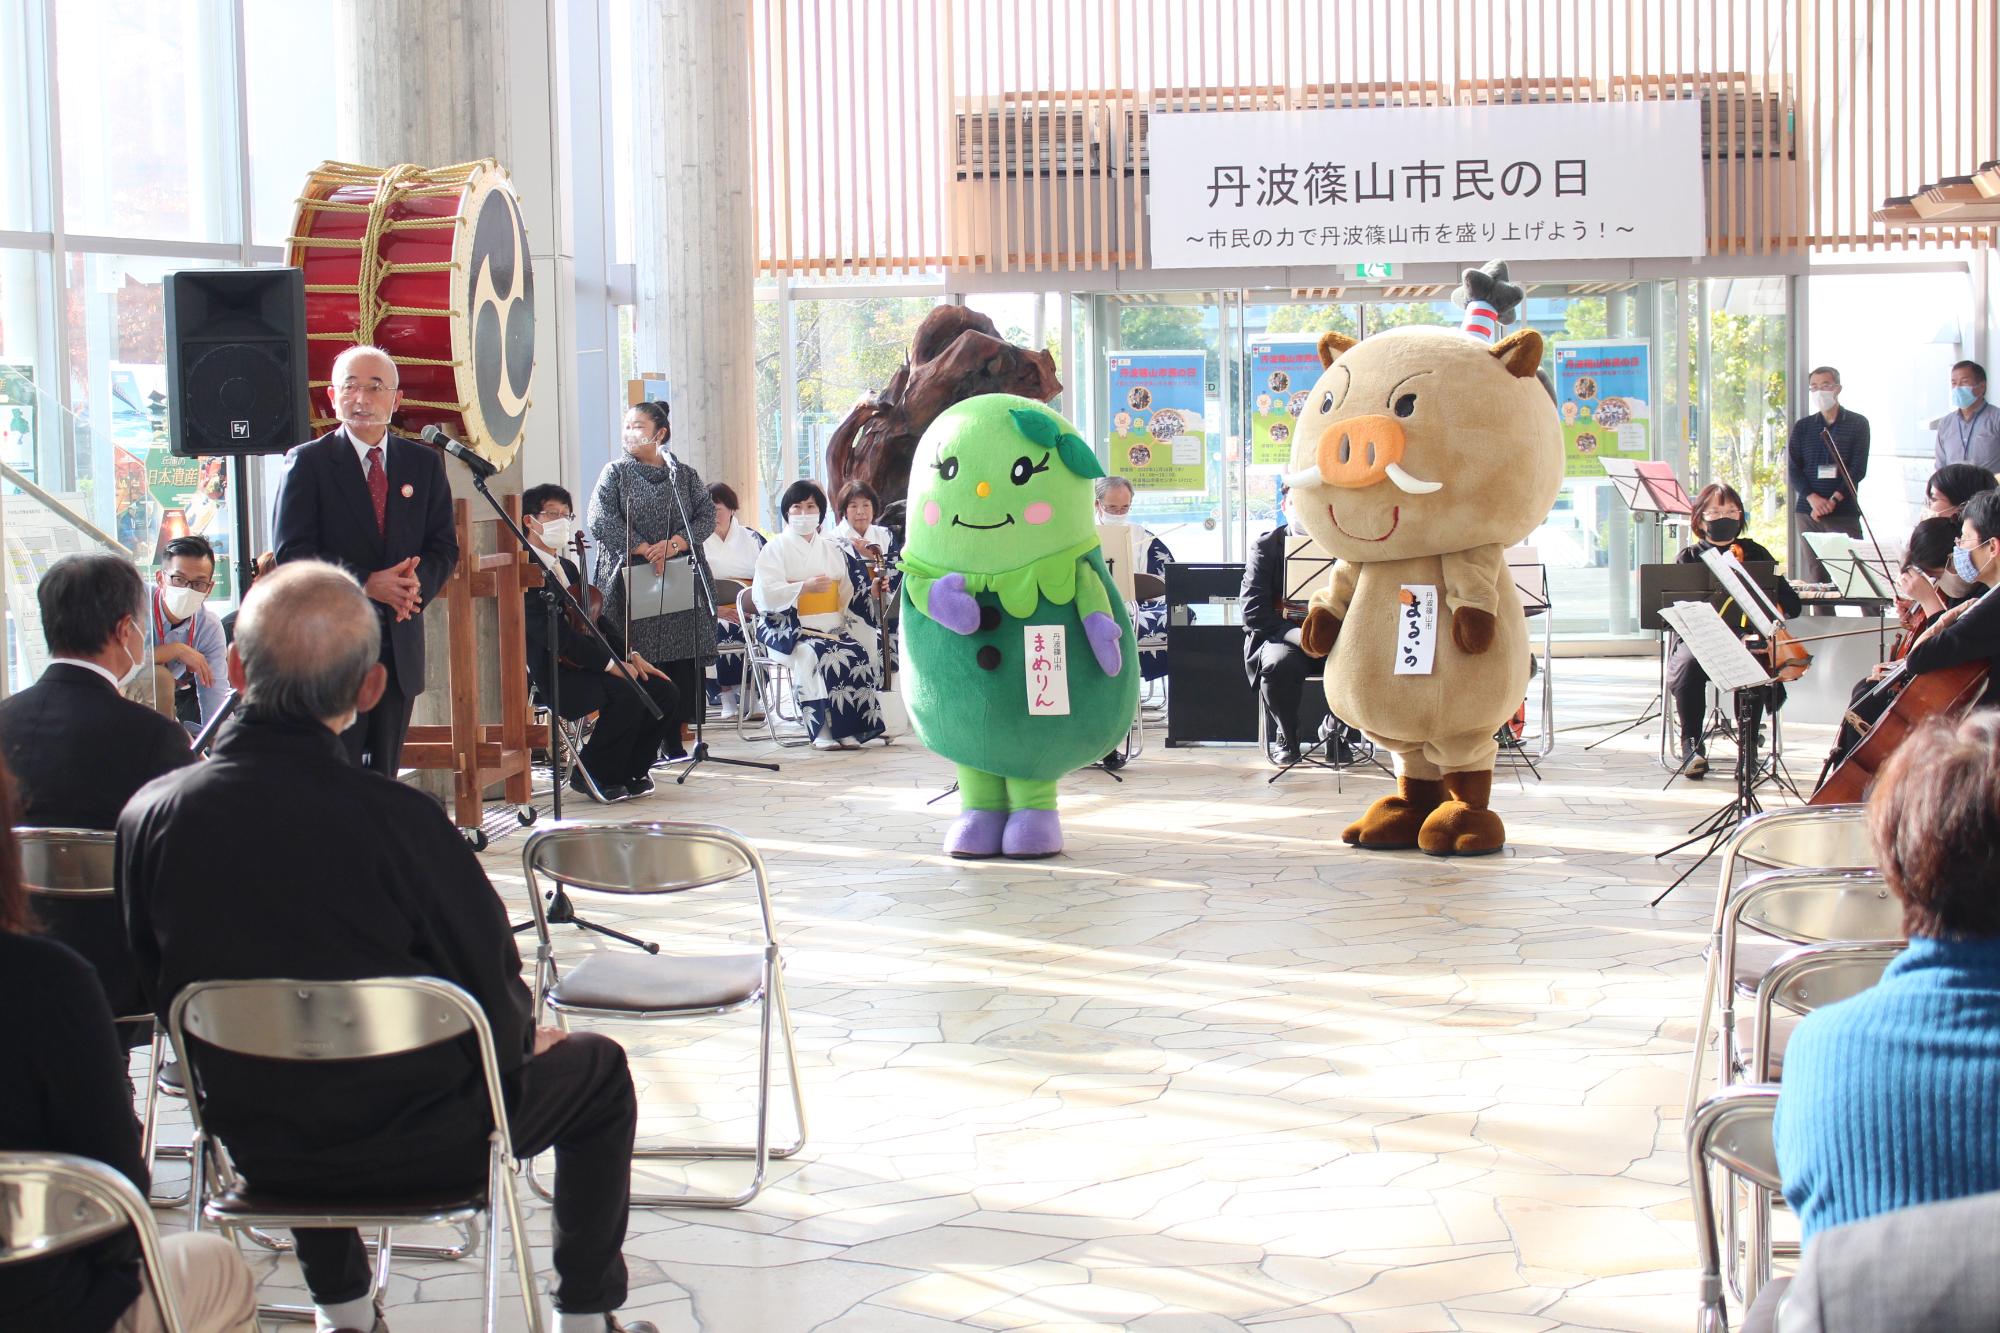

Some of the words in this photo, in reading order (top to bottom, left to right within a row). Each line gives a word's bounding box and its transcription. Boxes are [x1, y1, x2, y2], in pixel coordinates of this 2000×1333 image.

[1206, 158, 1588, 208] 丹波篠山市民の日
[149, 467, 198, 487] 日本遺産
[1032, 632, 1055, 707] まめりん
